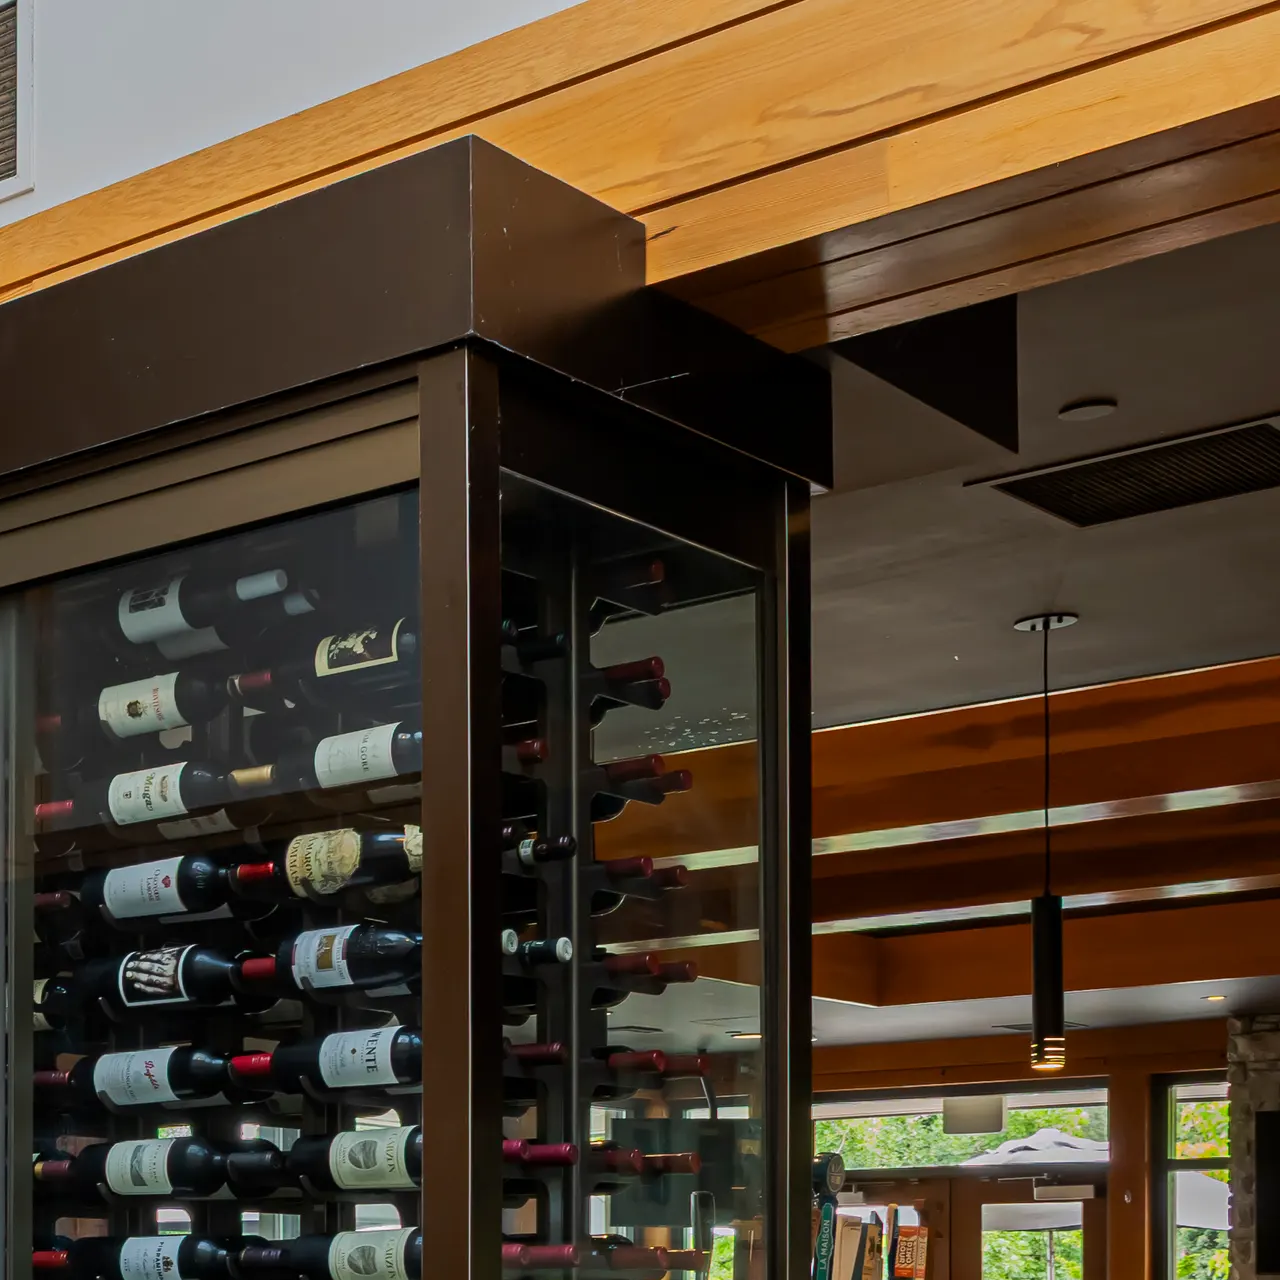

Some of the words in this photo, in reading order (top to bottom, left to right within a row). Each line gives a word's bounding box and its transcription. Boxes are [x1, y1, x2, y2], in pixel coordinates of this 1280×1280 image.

[360, 746, 370, 773] GORE
[365, 1031, 382, 1074] WENTE
[820, 1219, 830, 1257] MAISON
[819, 1258, 827, 1271] LA
[898, 1240, 907, 1264] SOUR
[905, 1240, 914, 1264] DINO
